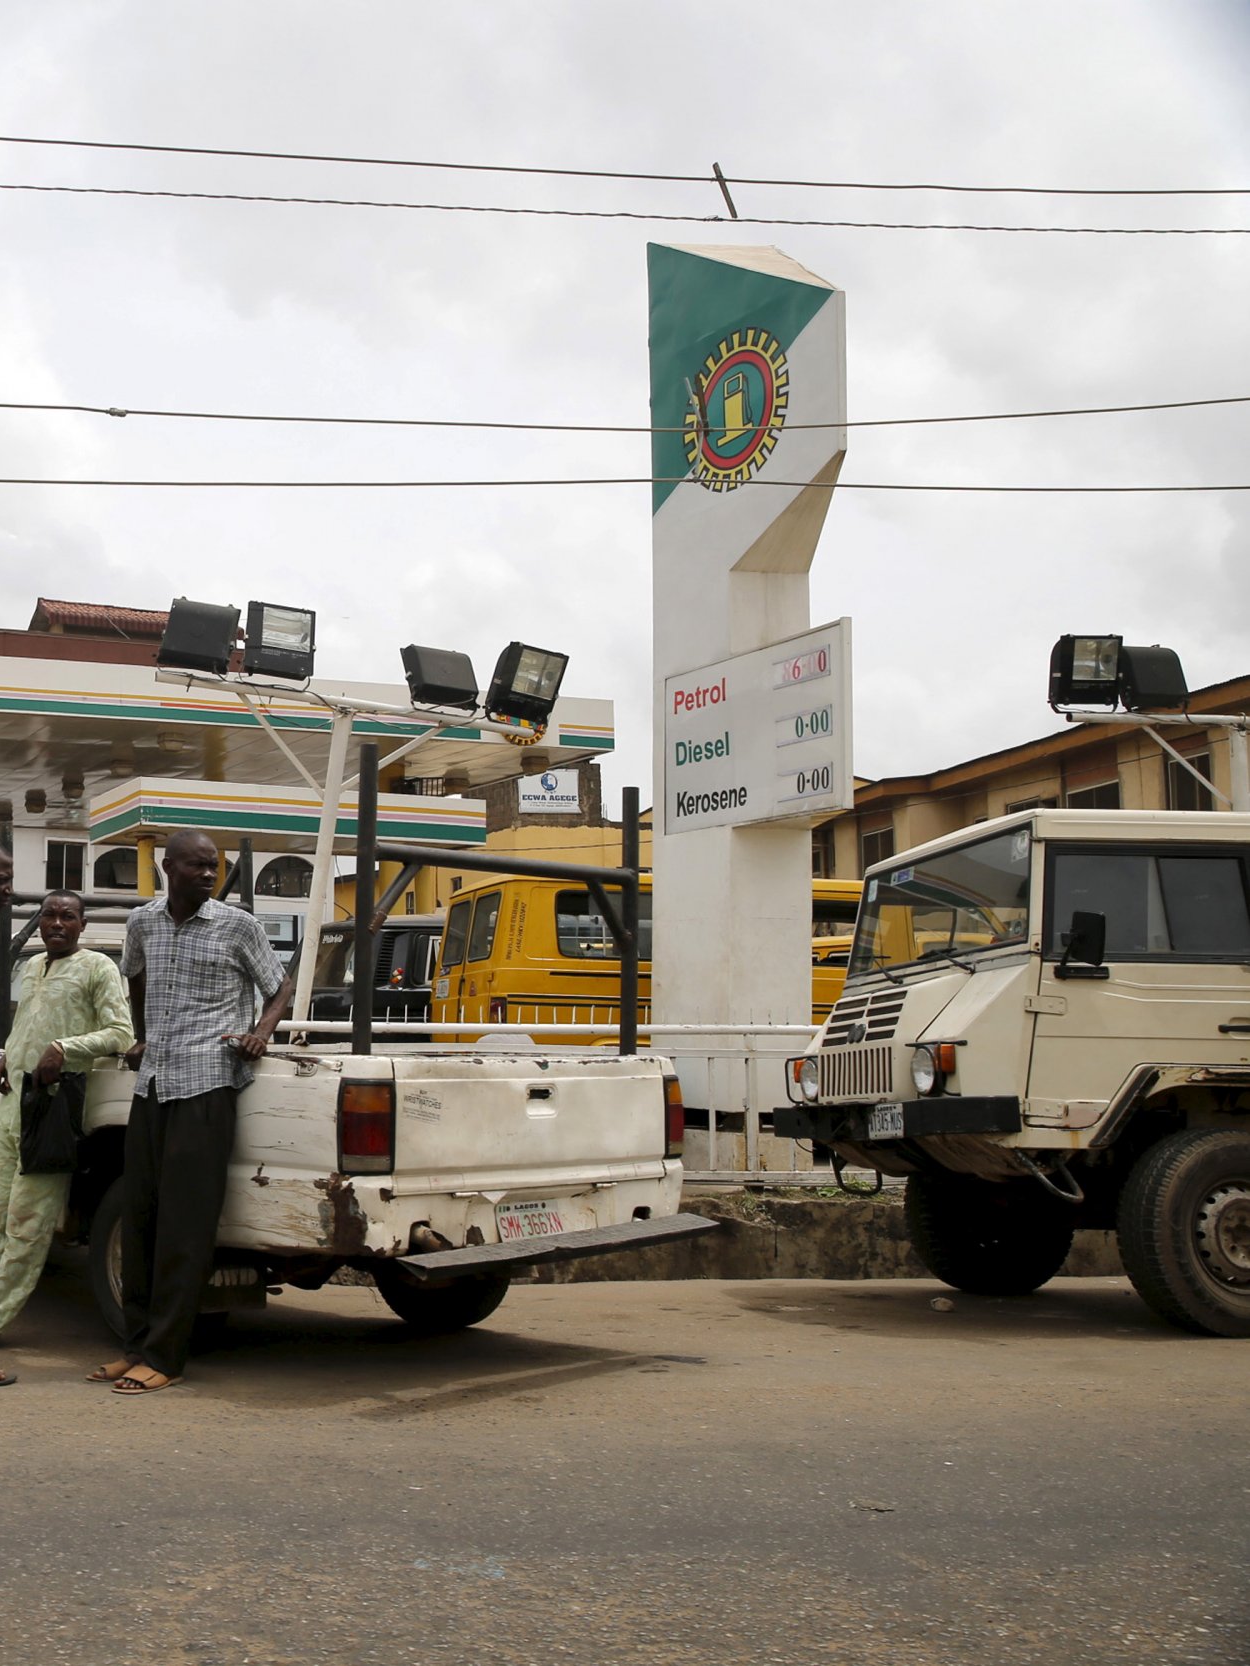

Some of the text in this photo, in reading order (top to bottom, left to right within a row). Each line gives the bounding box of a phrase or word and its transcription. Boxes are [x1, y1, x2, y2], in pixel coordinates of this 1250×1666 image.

[674, 677, 726, 714] Petrol
[675, 731, 730, 766] Diesel
[676, 786, 747, 817] Kerosene
